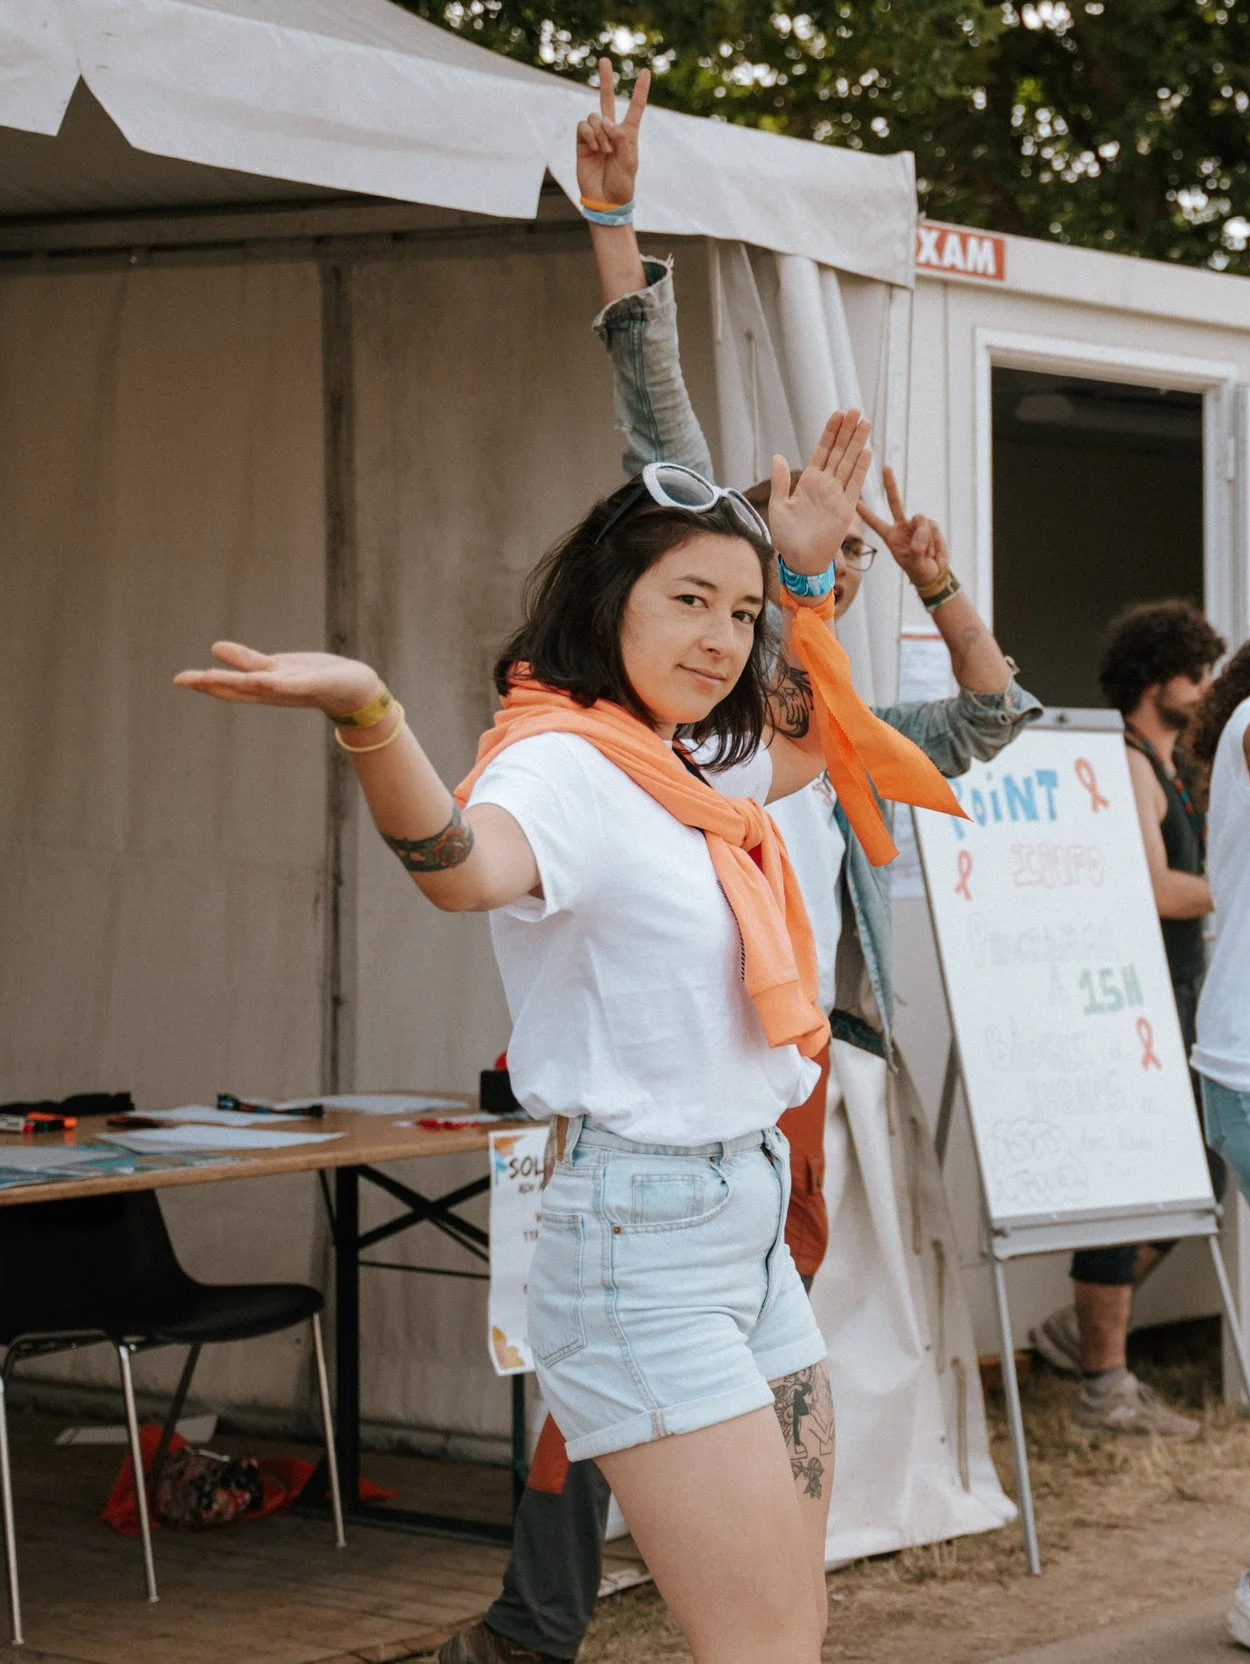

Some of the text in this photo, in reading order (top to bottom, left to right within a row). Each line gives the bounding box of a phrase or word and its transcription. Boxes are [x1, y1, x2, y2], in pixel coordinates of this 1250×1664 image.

[918, 227, 996, 276] XAM
[1010, 842, 1104, 889] INFO
[1079, 964, 1144, 1014] 15H
